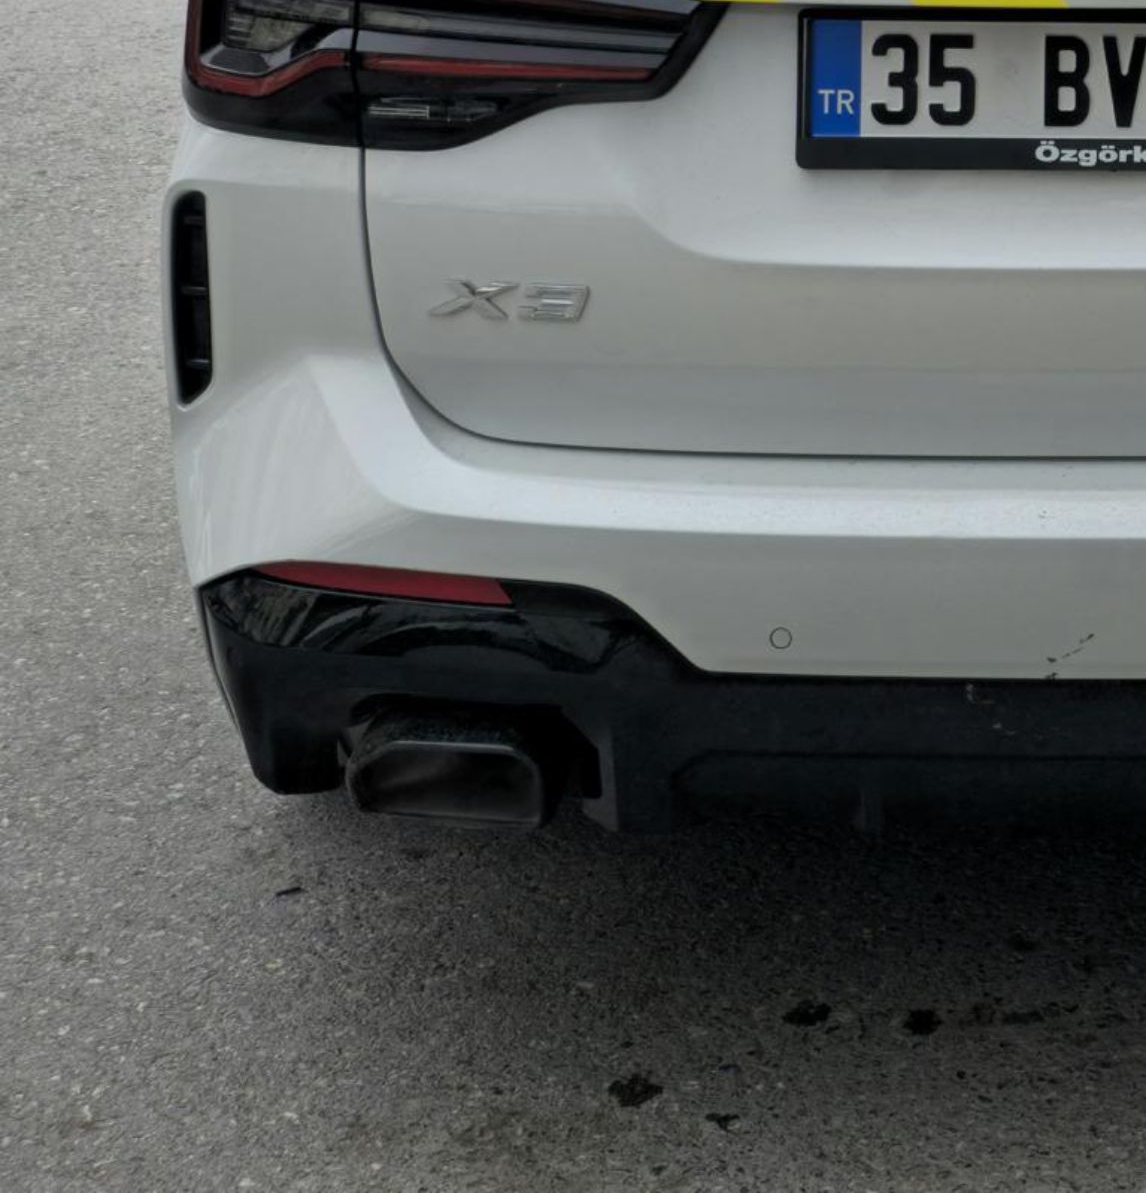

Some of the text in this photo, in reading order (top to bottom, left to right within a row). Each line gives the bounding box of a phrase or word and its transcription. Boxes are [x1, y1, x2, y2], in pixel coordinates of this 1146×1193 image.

[870, 33, 977, 126] 35
[817, 89, 855, 115] TR
[428, 280, 591, 322] X3
